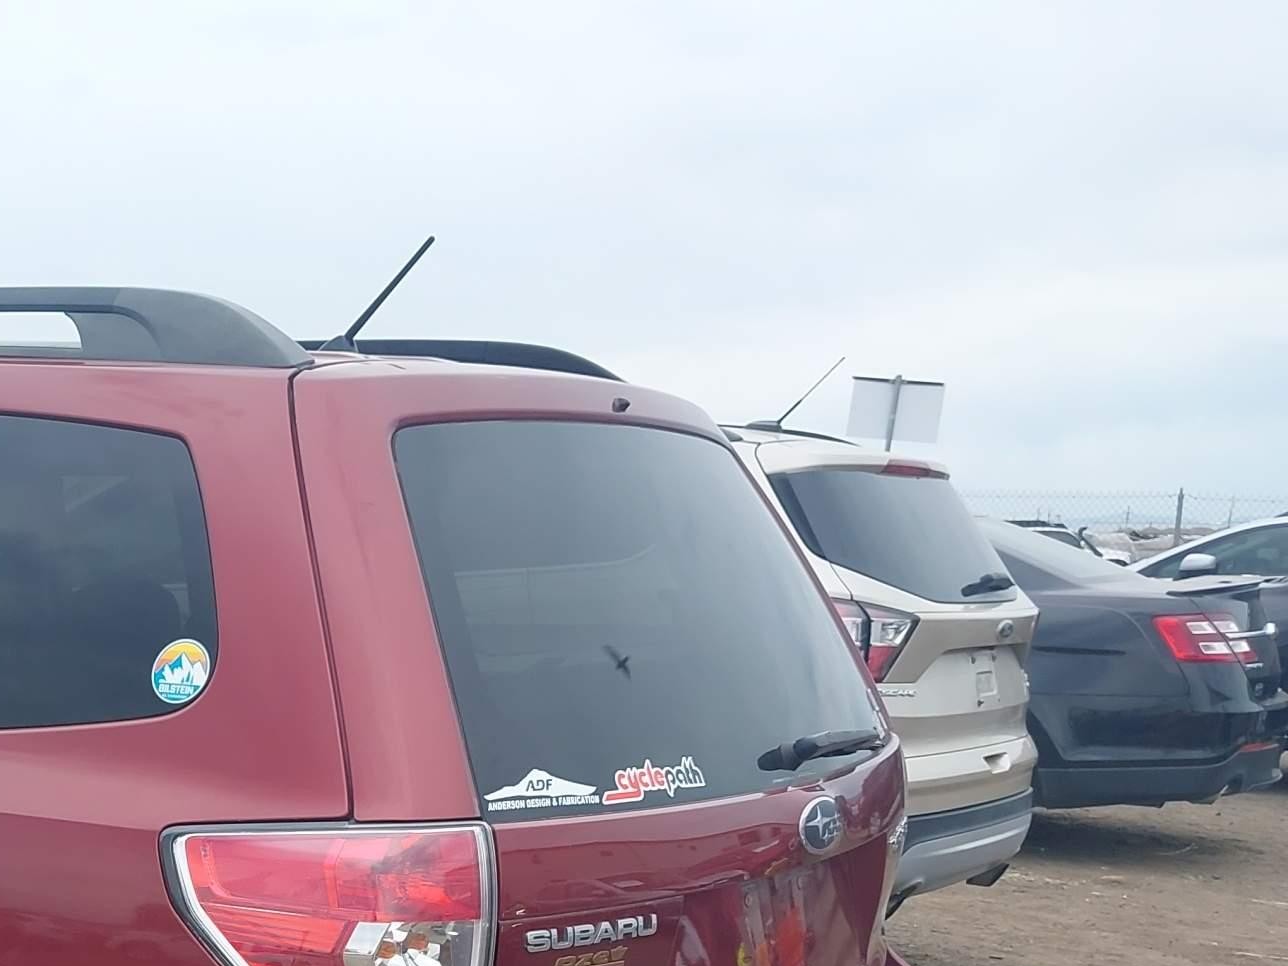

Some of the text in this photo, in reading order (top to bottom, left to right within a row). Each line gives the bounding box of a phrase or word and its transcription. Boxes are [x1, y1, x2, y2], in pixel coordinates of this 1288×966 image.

[526, 779, 553, 792] ADF
[603, 757, 706, 804] cyclepath
[487, 794, 600, 812] ANDERSON DESIGN & FABRICATION
[525, 913, 658, 953] SUBARU
